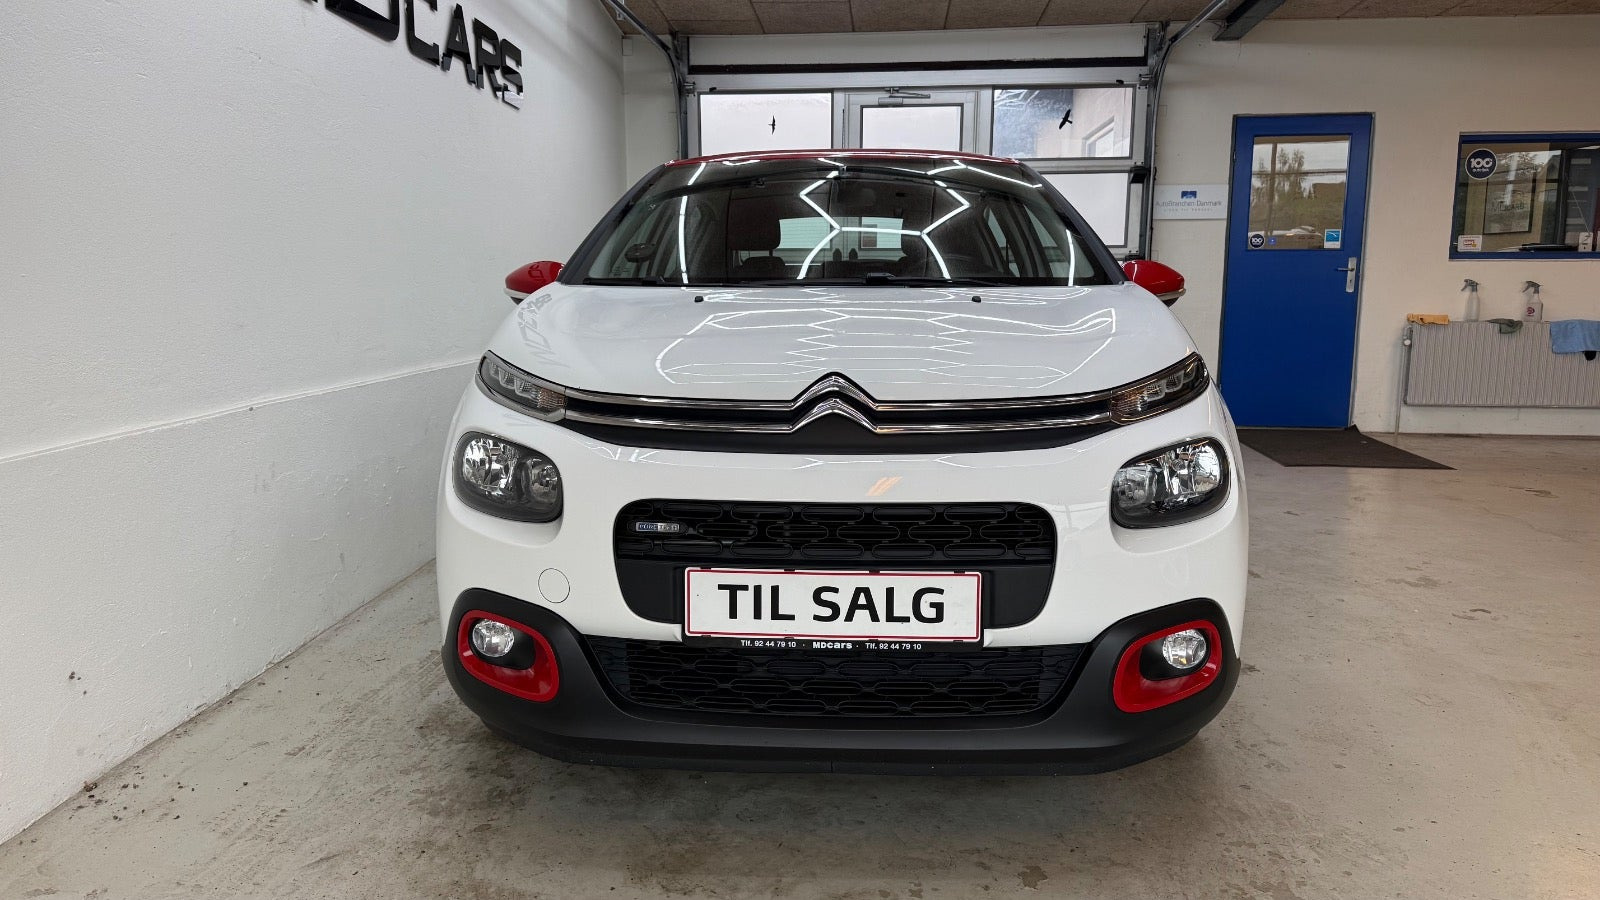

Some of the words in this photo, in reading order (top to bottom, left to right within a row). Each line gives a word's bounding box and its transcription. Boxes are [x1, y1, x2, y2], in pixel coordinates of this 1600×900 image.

[300, 0, 524, 110] CARS
[717, 584, 795, 621] TIL
[812, 585, 945, 624] SALG
[740, 639, 753, 647] Tlf.
[812, 641, 853, 649] MDcars
[879, 642, 889, 650] 92
